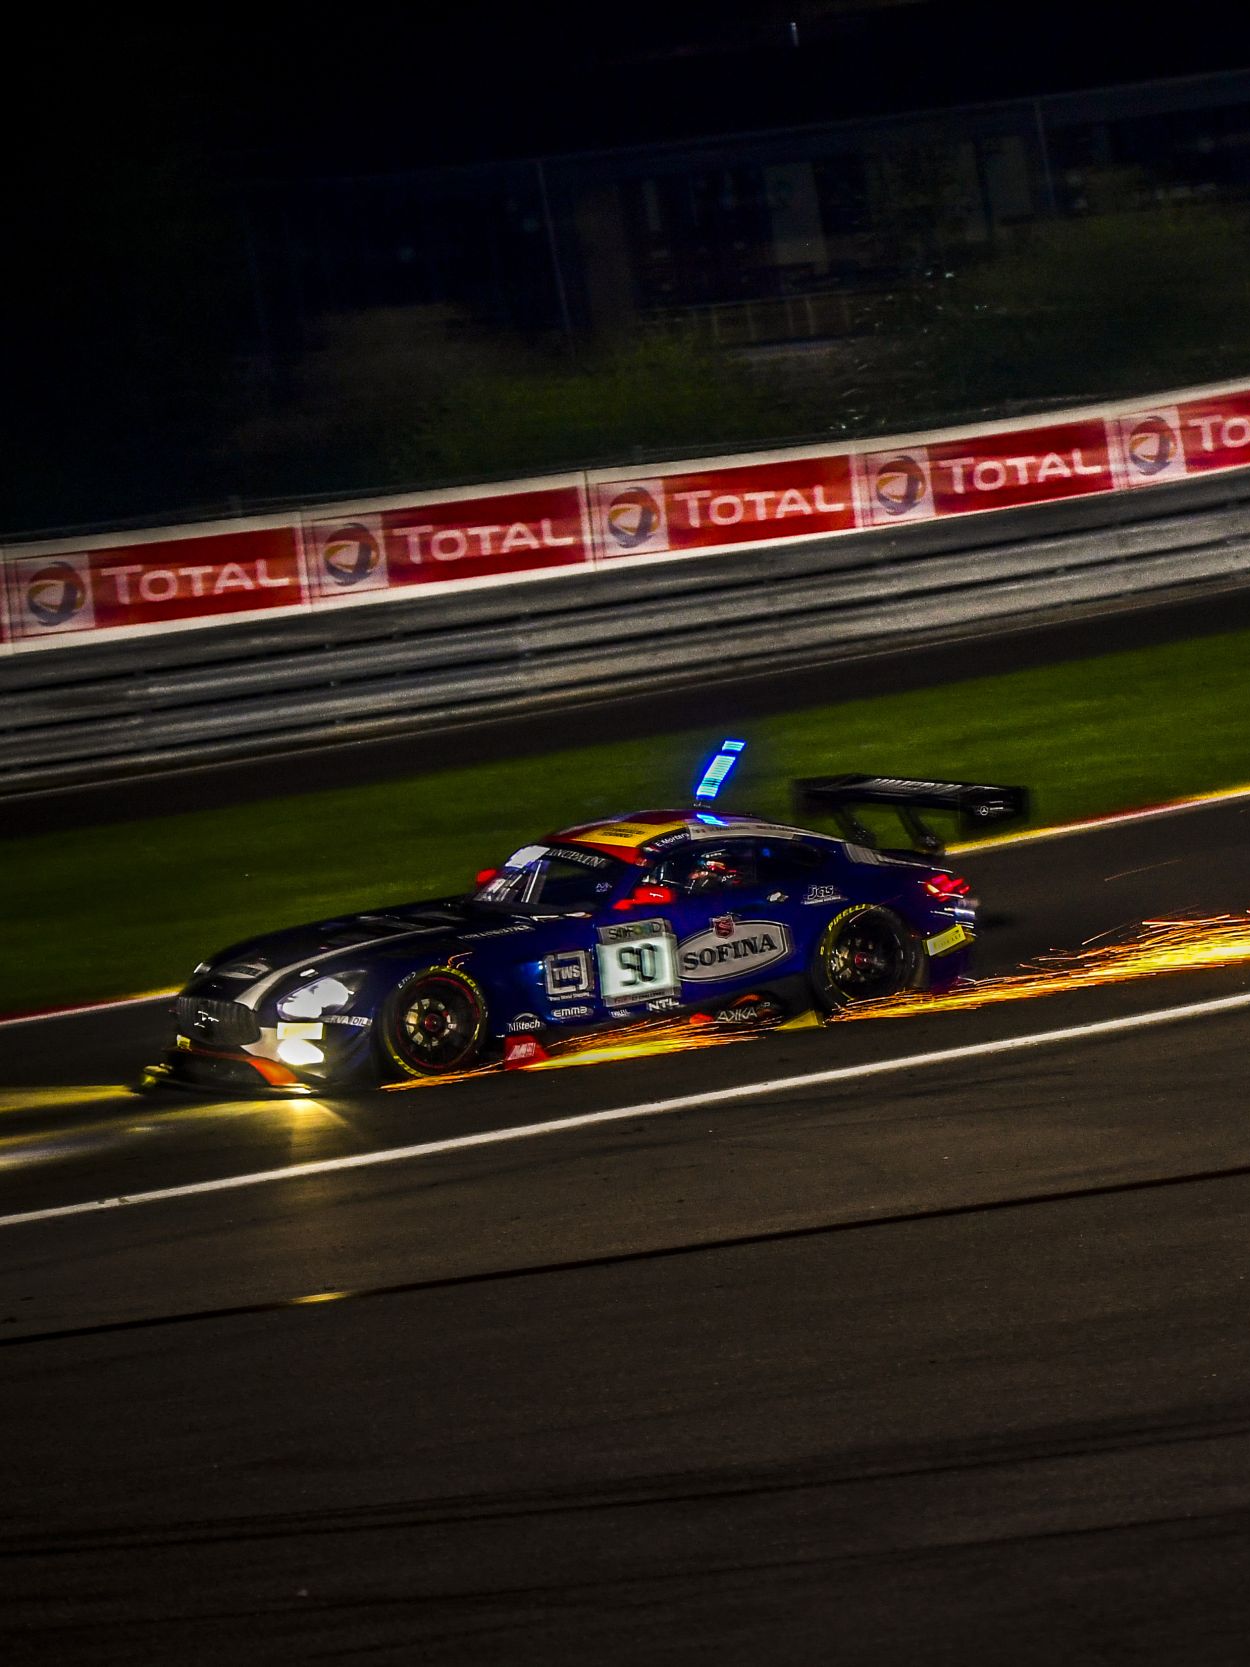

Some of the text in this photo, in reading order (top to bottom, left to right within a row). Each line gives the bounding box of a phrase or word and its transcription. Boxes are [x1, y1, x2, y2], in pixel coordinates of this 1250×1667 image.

[947, 448, 1104, 496] TOTAL
[675, 486, 845, 529] TOTAL
[397, 516, 575, 565] TOTAL
[100, 558, 290, 607] TOTAL
[553, 964, 582, 981] TWS
[682, 933, 778, 972] SOFINA
[648, 997, 679, 1012] NTL
